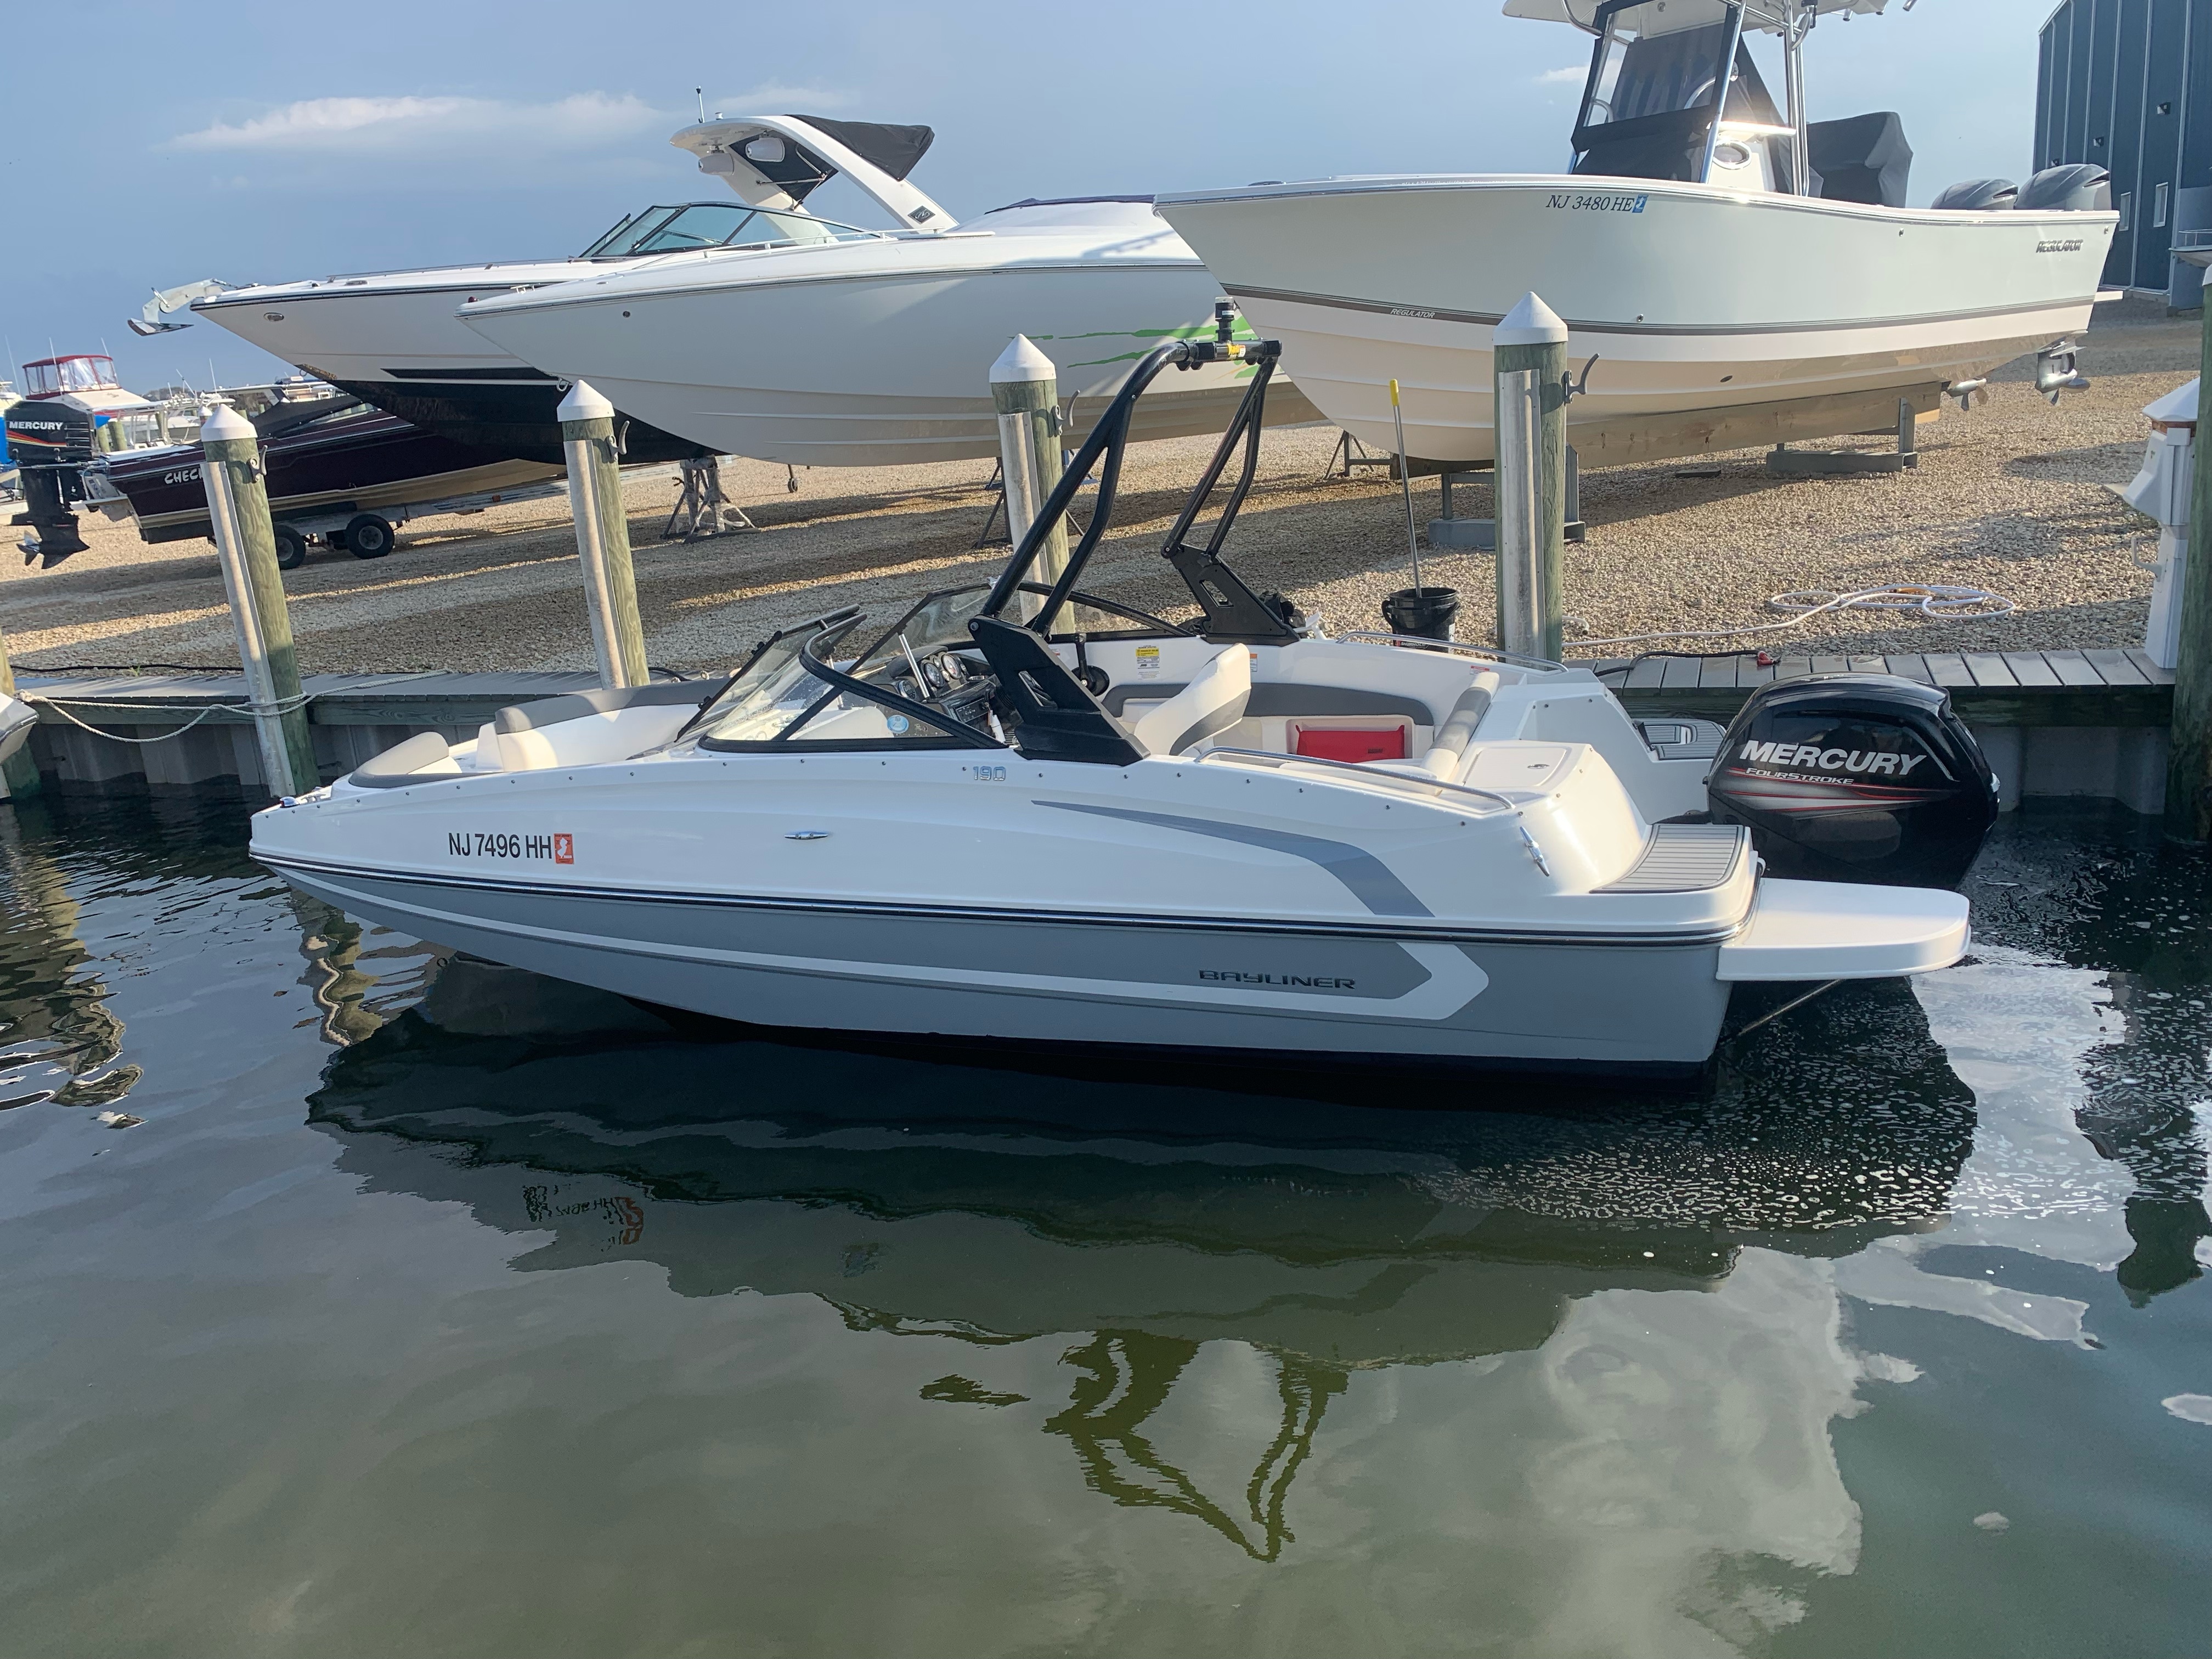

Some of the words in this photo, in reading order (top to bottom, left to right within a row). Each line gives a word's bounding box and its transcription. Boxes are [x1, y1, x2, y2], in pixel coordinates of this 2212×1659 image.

[1545, 195, 1571, 208] NJ
[1572, 195, 1610, 211] 3480
[1610, 197, 1635, 212] HE
[1390, 308, 1436, 318] REGULATOR
[9, 421, 64, 431] MERCURY
[1739, 740, 1927, 775] MERCURY
[973, 765, 1006, 781] 190
[448, 832, 470, 856] NJ
[475, 833, 521, 858] 7496
[525, 835, 552, 859] HH
[1199, 969, 1356, 989] BAYLINER
